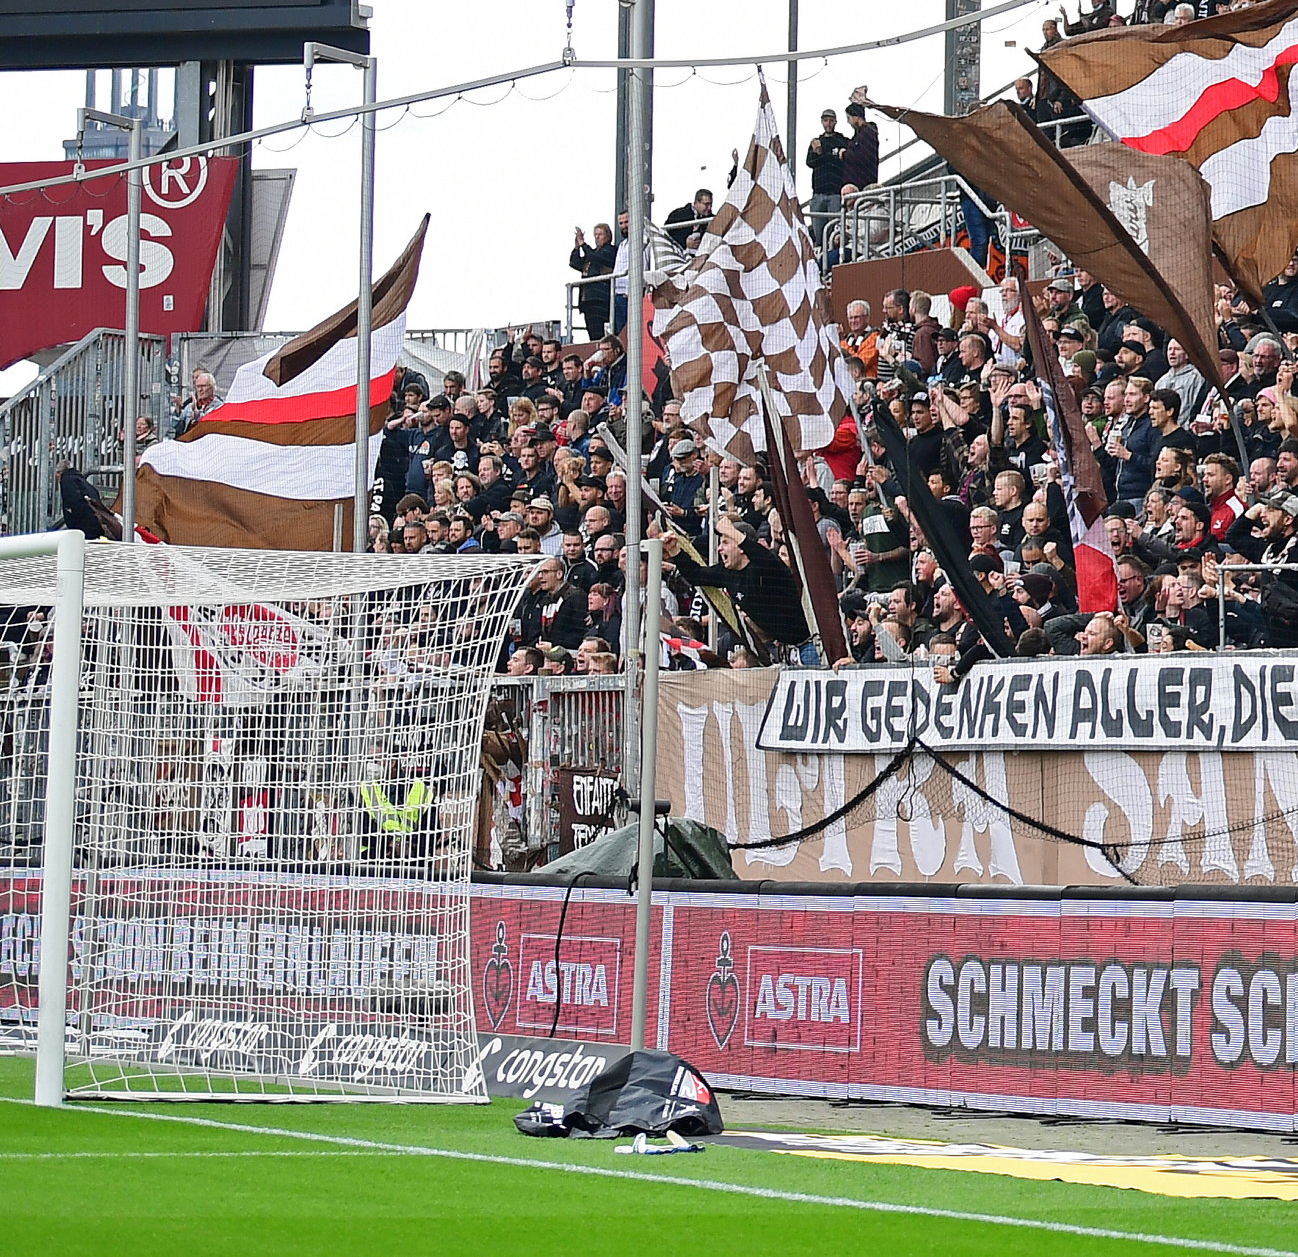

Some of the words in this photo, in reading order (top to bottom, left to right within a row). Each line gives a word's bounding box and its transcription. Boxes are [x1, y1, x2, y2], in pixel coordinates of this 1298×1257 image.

[780, 679, 847, 743] WIR
[861, 673, 1058, 740] GEDENKEN
[1070, 667, 1226, 749] ALLER,
[1232, 664, 1294, 743] DIE
[525, 958, 609, 1008] ASTRA
[755, 973, 851, 1024] ASTRA
[925, 956, 1200, 1058] SCHMECKT
[496, 1044, 607, 1099] congstar
